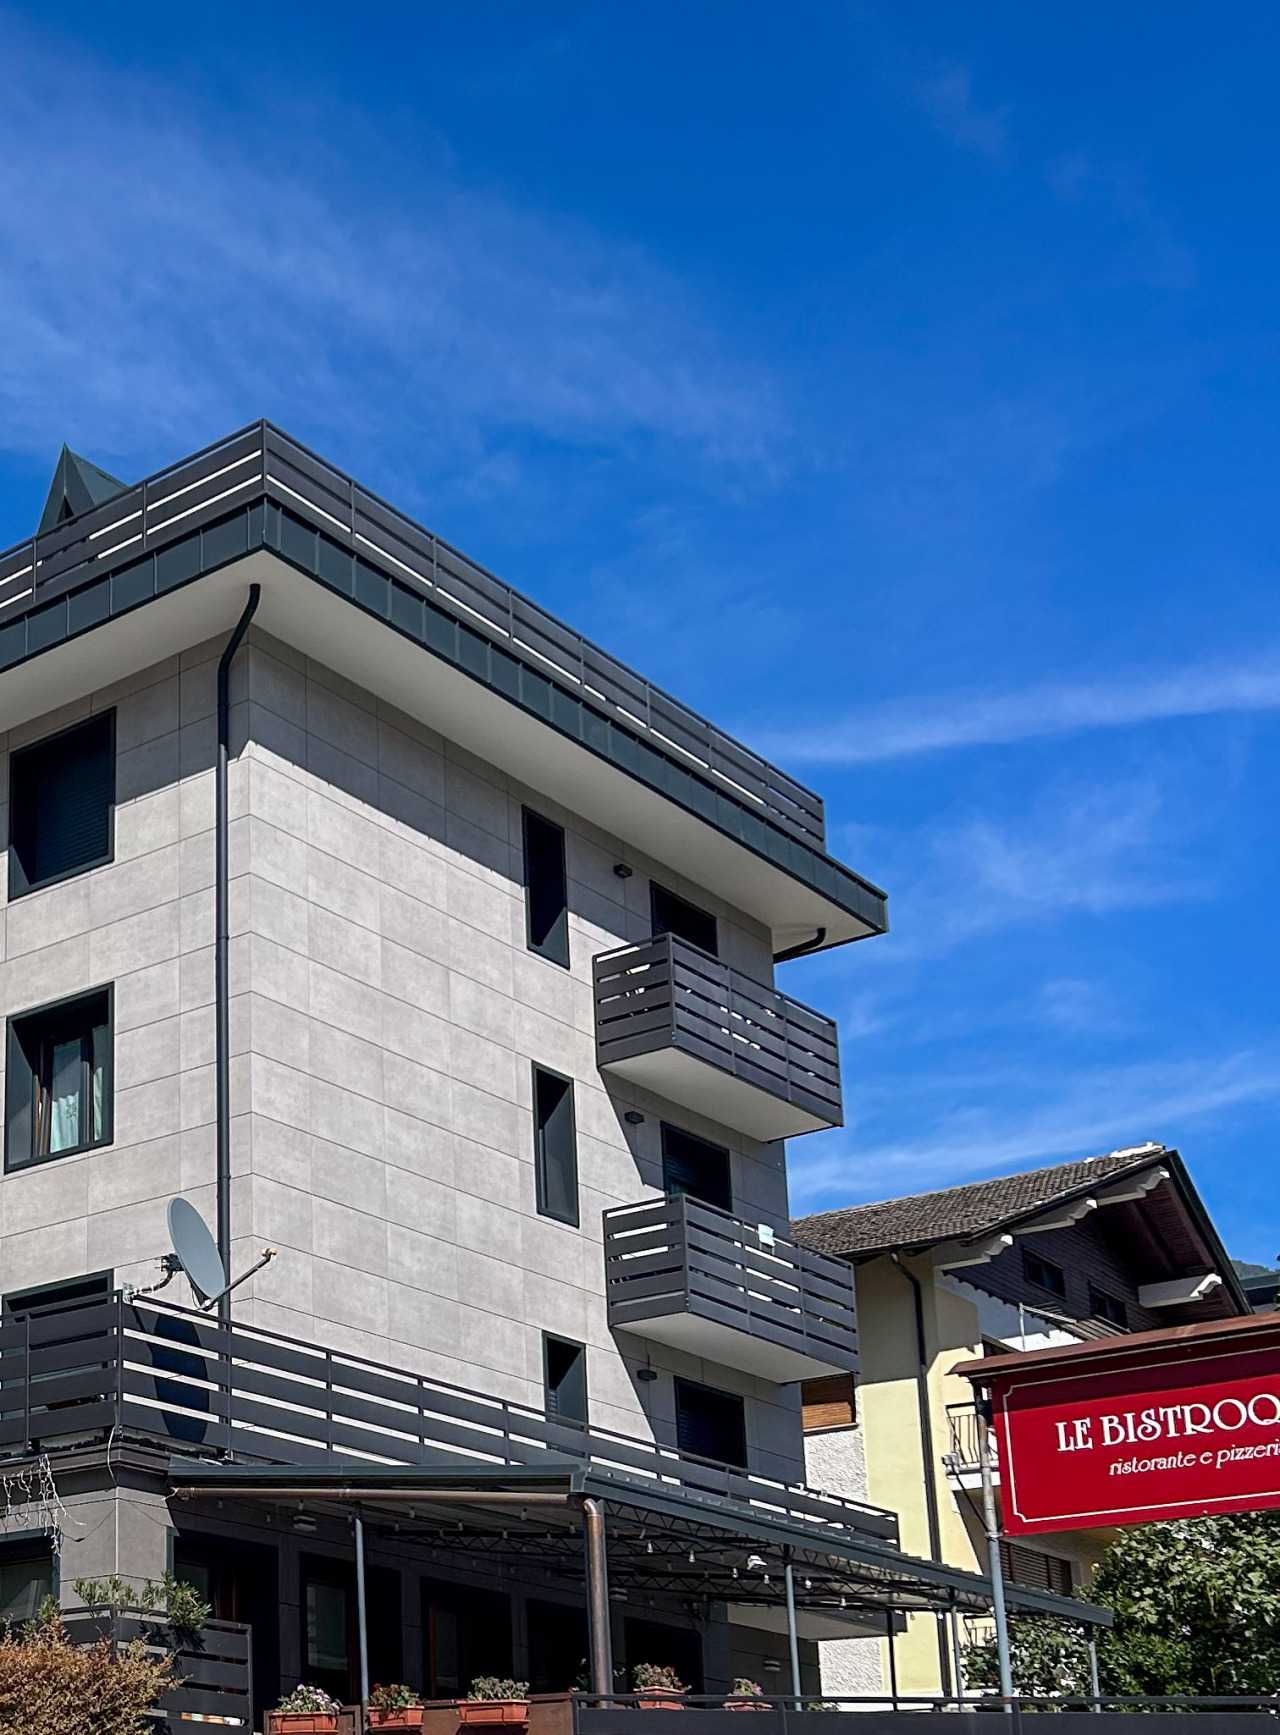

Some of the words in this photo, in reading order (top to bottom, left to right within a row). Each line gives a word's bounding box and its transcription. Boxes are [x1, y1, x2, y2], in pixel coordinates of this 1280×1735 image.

[1055, 1417, 1094, 1452] LE
[1109, 1451, 1197, 1475] ristorante
[1199, 1451, 1213, 1464] e
[1215, 1438, 1280, 1469] pizzeri
